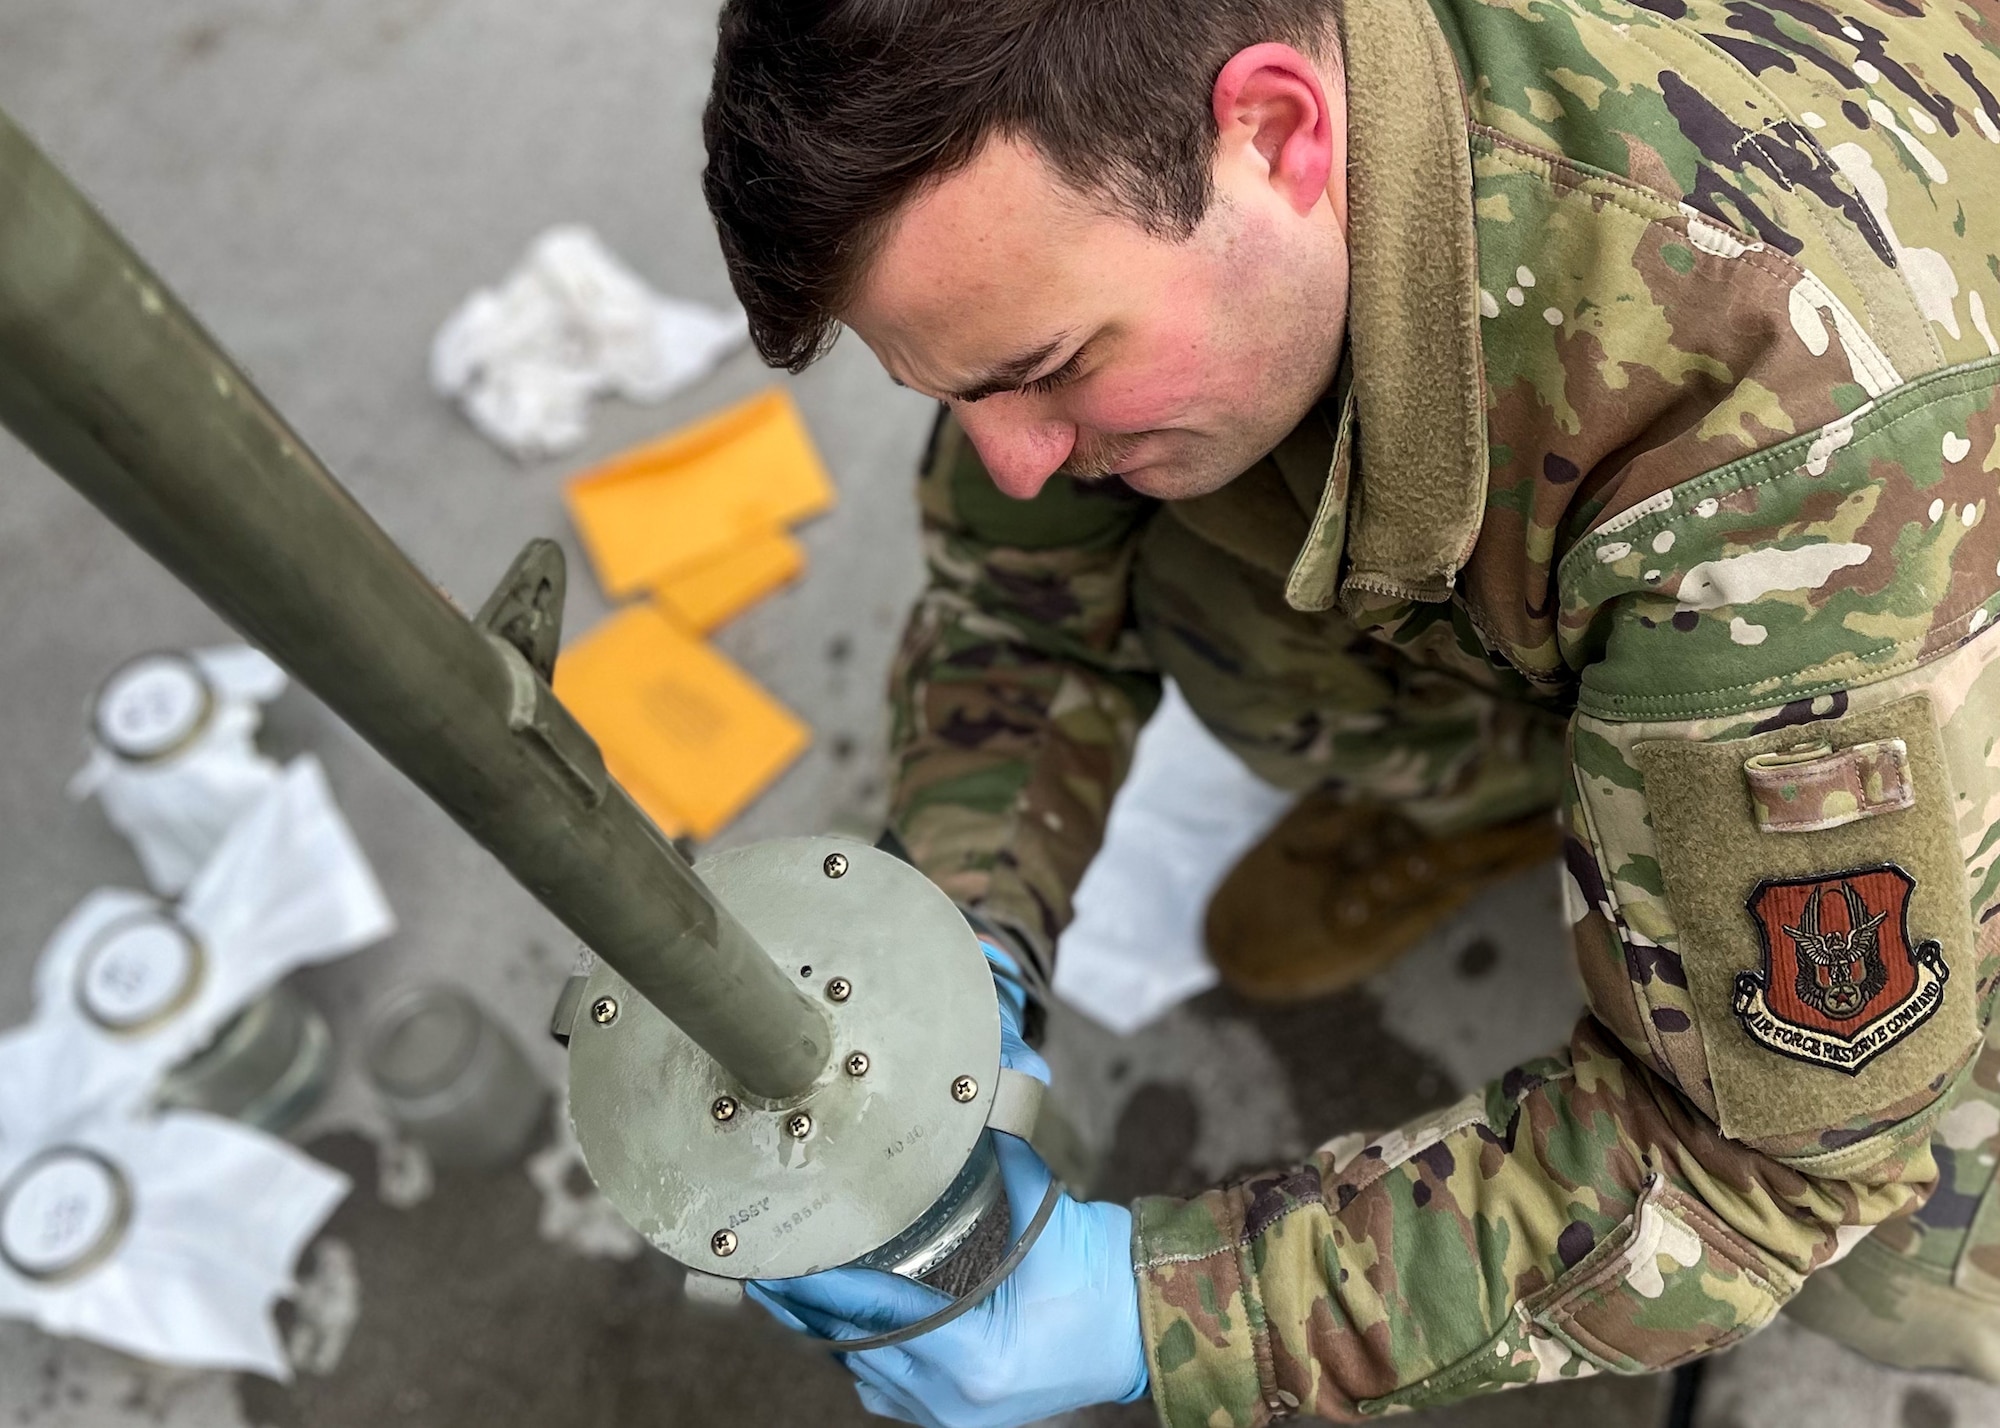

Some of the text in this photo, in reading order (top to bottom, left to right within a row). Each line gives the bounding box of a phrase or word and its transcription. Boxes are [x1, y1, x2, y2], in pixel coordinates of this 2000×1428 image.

[1751, 981, 1939, 1062] AIR FORCE RESERVE COMMAND
